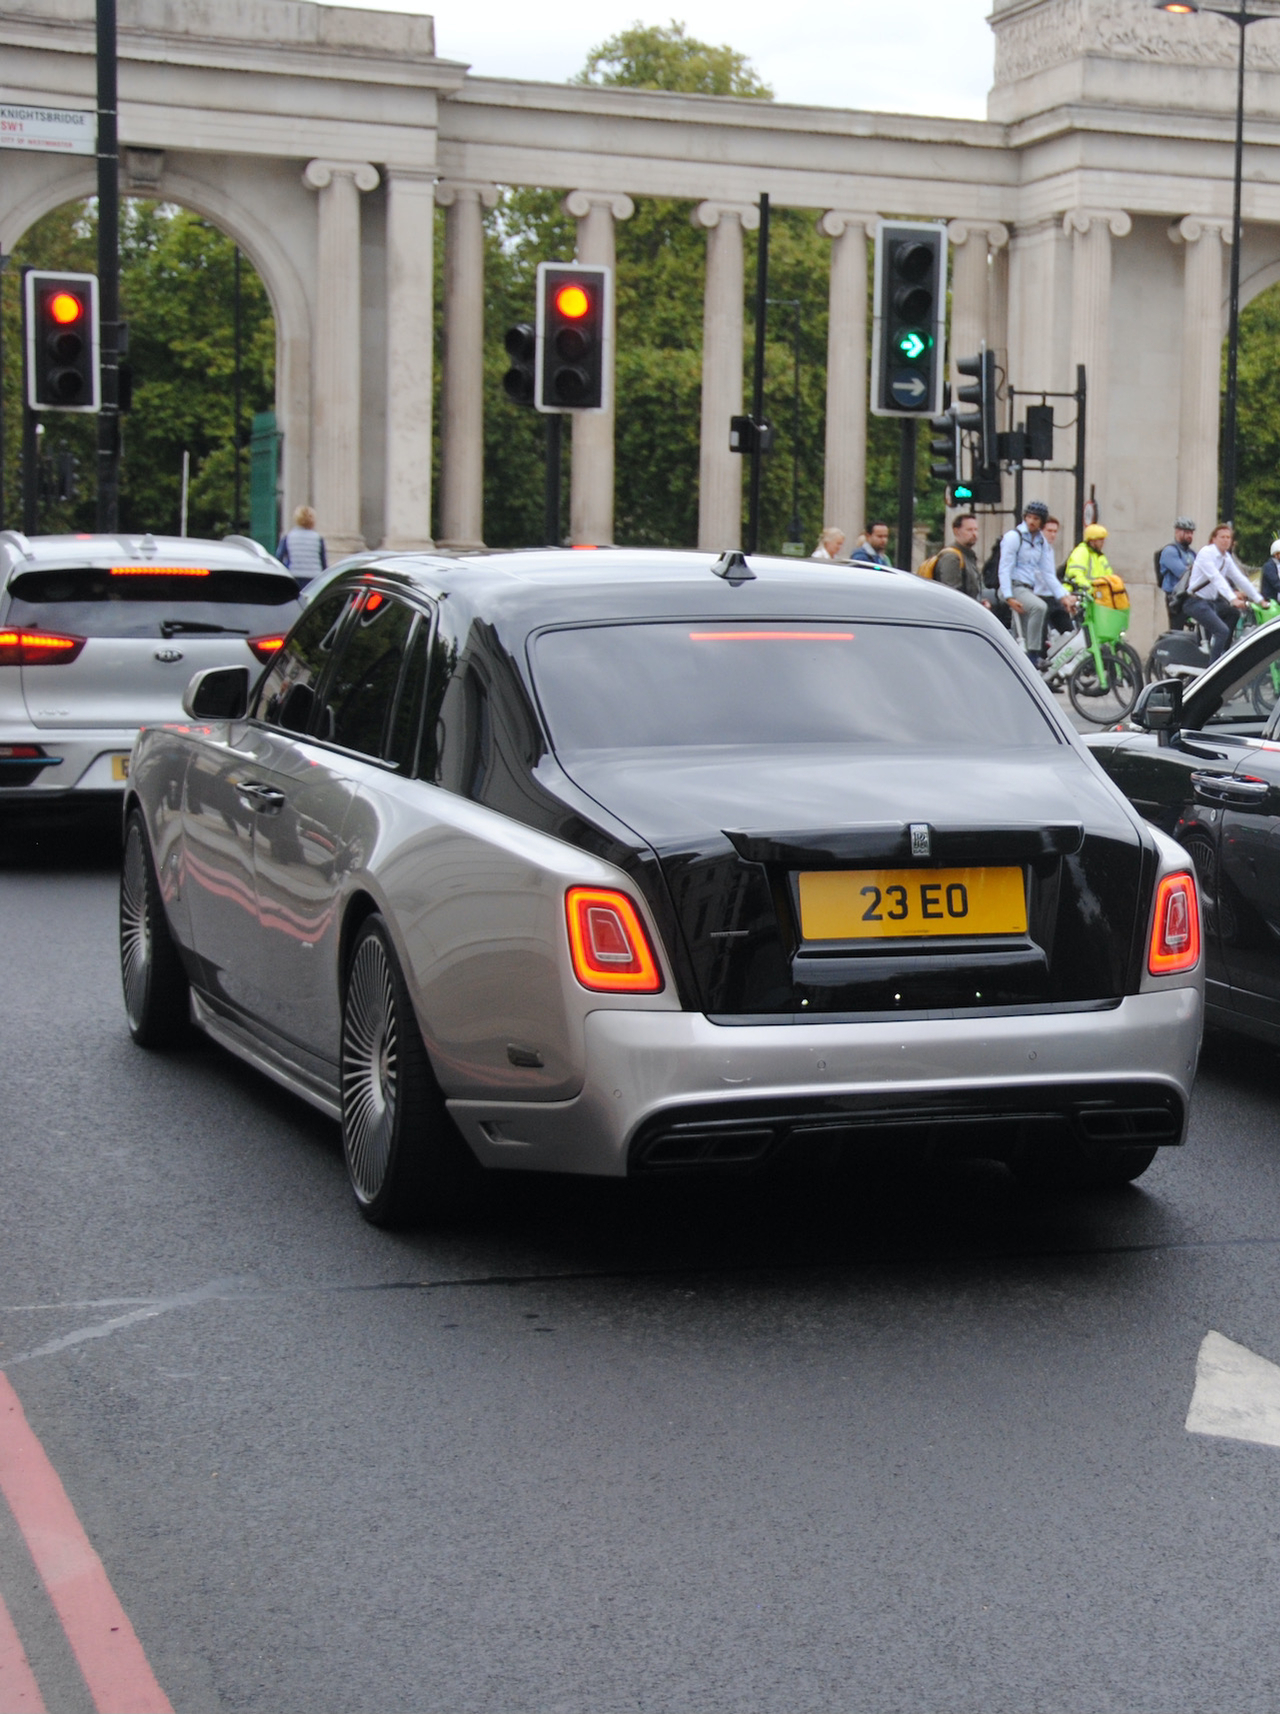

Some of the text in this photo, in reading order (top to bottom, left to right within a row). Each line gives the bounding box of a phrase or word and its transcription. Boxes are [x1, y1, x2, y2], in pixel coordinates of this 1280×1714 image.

[0, 108, 85, 125] KNIGHTSBRIDGE
[1, 121, 24, 132] SW1
[859, 883, 969, 921] 23 EO
